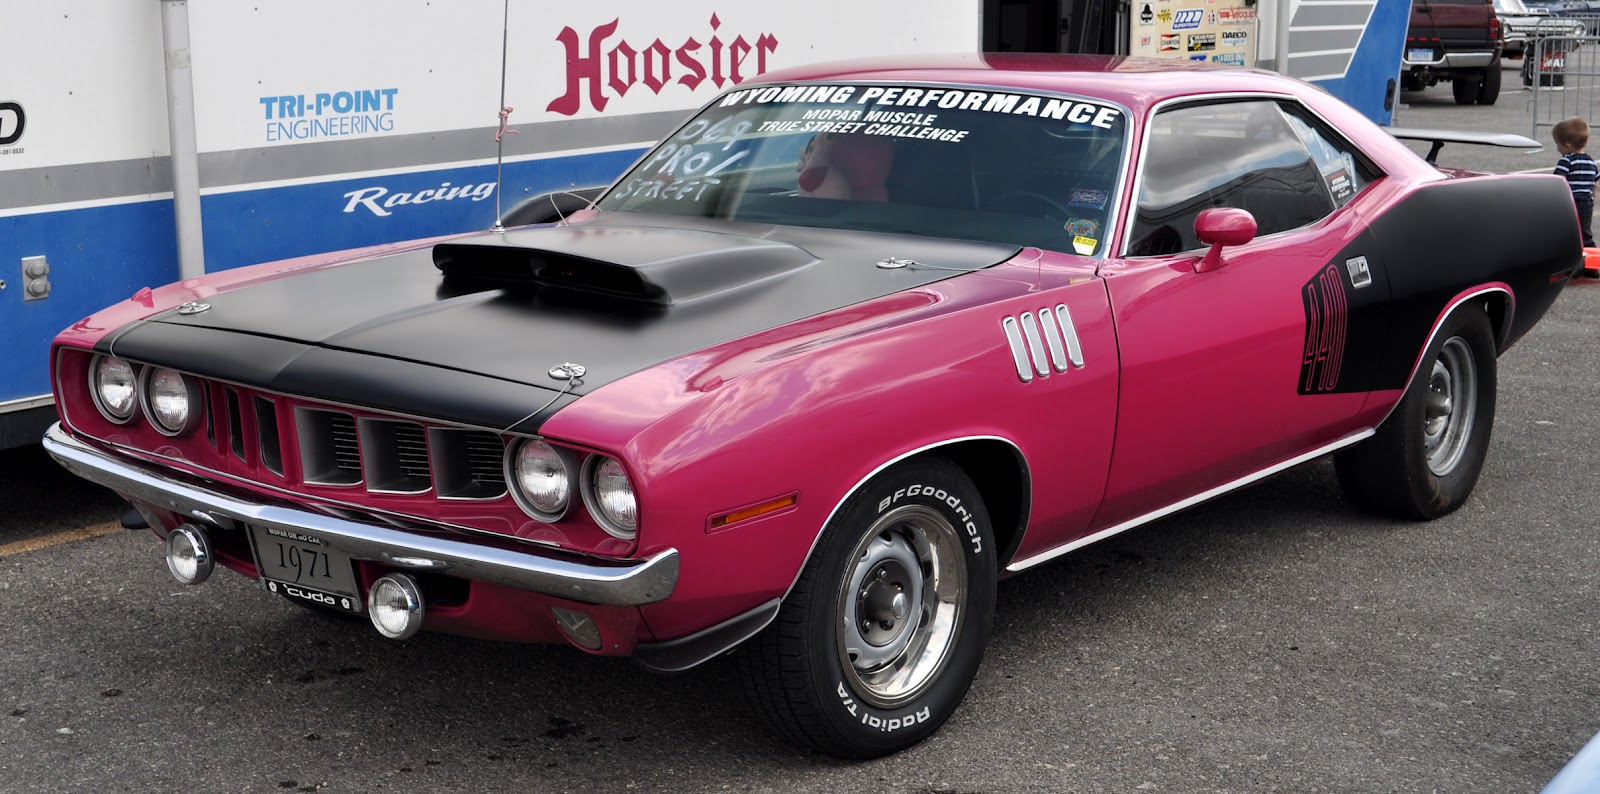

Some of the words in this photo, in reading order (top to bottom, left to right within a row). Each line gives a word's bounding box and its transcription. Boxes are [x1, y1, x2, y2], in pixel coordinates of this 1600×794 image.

[546, 11, 778, 116] Hoosier
[260, 88, 398, 120] TRI-POINT
[719, 86, 856, 107] WYOMING
[857, 87, 1119, 129] PERFORMANCE
[802, 109, 862, 122] MOPAR
[862, 110, 938, 127] MUSCLE
[266, 113, 394, 141] ENGINEERING
[757, 121, 802, 132] TRUE
[800, 121, 866, 134] STREET
[864, 123, 969, 143] CHALLENGE
[343, 181, 497, 216] Racing
[615, 178, 721, 202] STREET
[1304, 264, 1347, 391] 440
[878, 484, 982, 554] BFGoodrich
[268, 528, 288, 537] MOPAR
[308, 535, 320, 544] CAR
[276, 543, 333, 584] 1971
[837, 681, 857, 717] T/A
[861, 705, 931, 731] Radial
